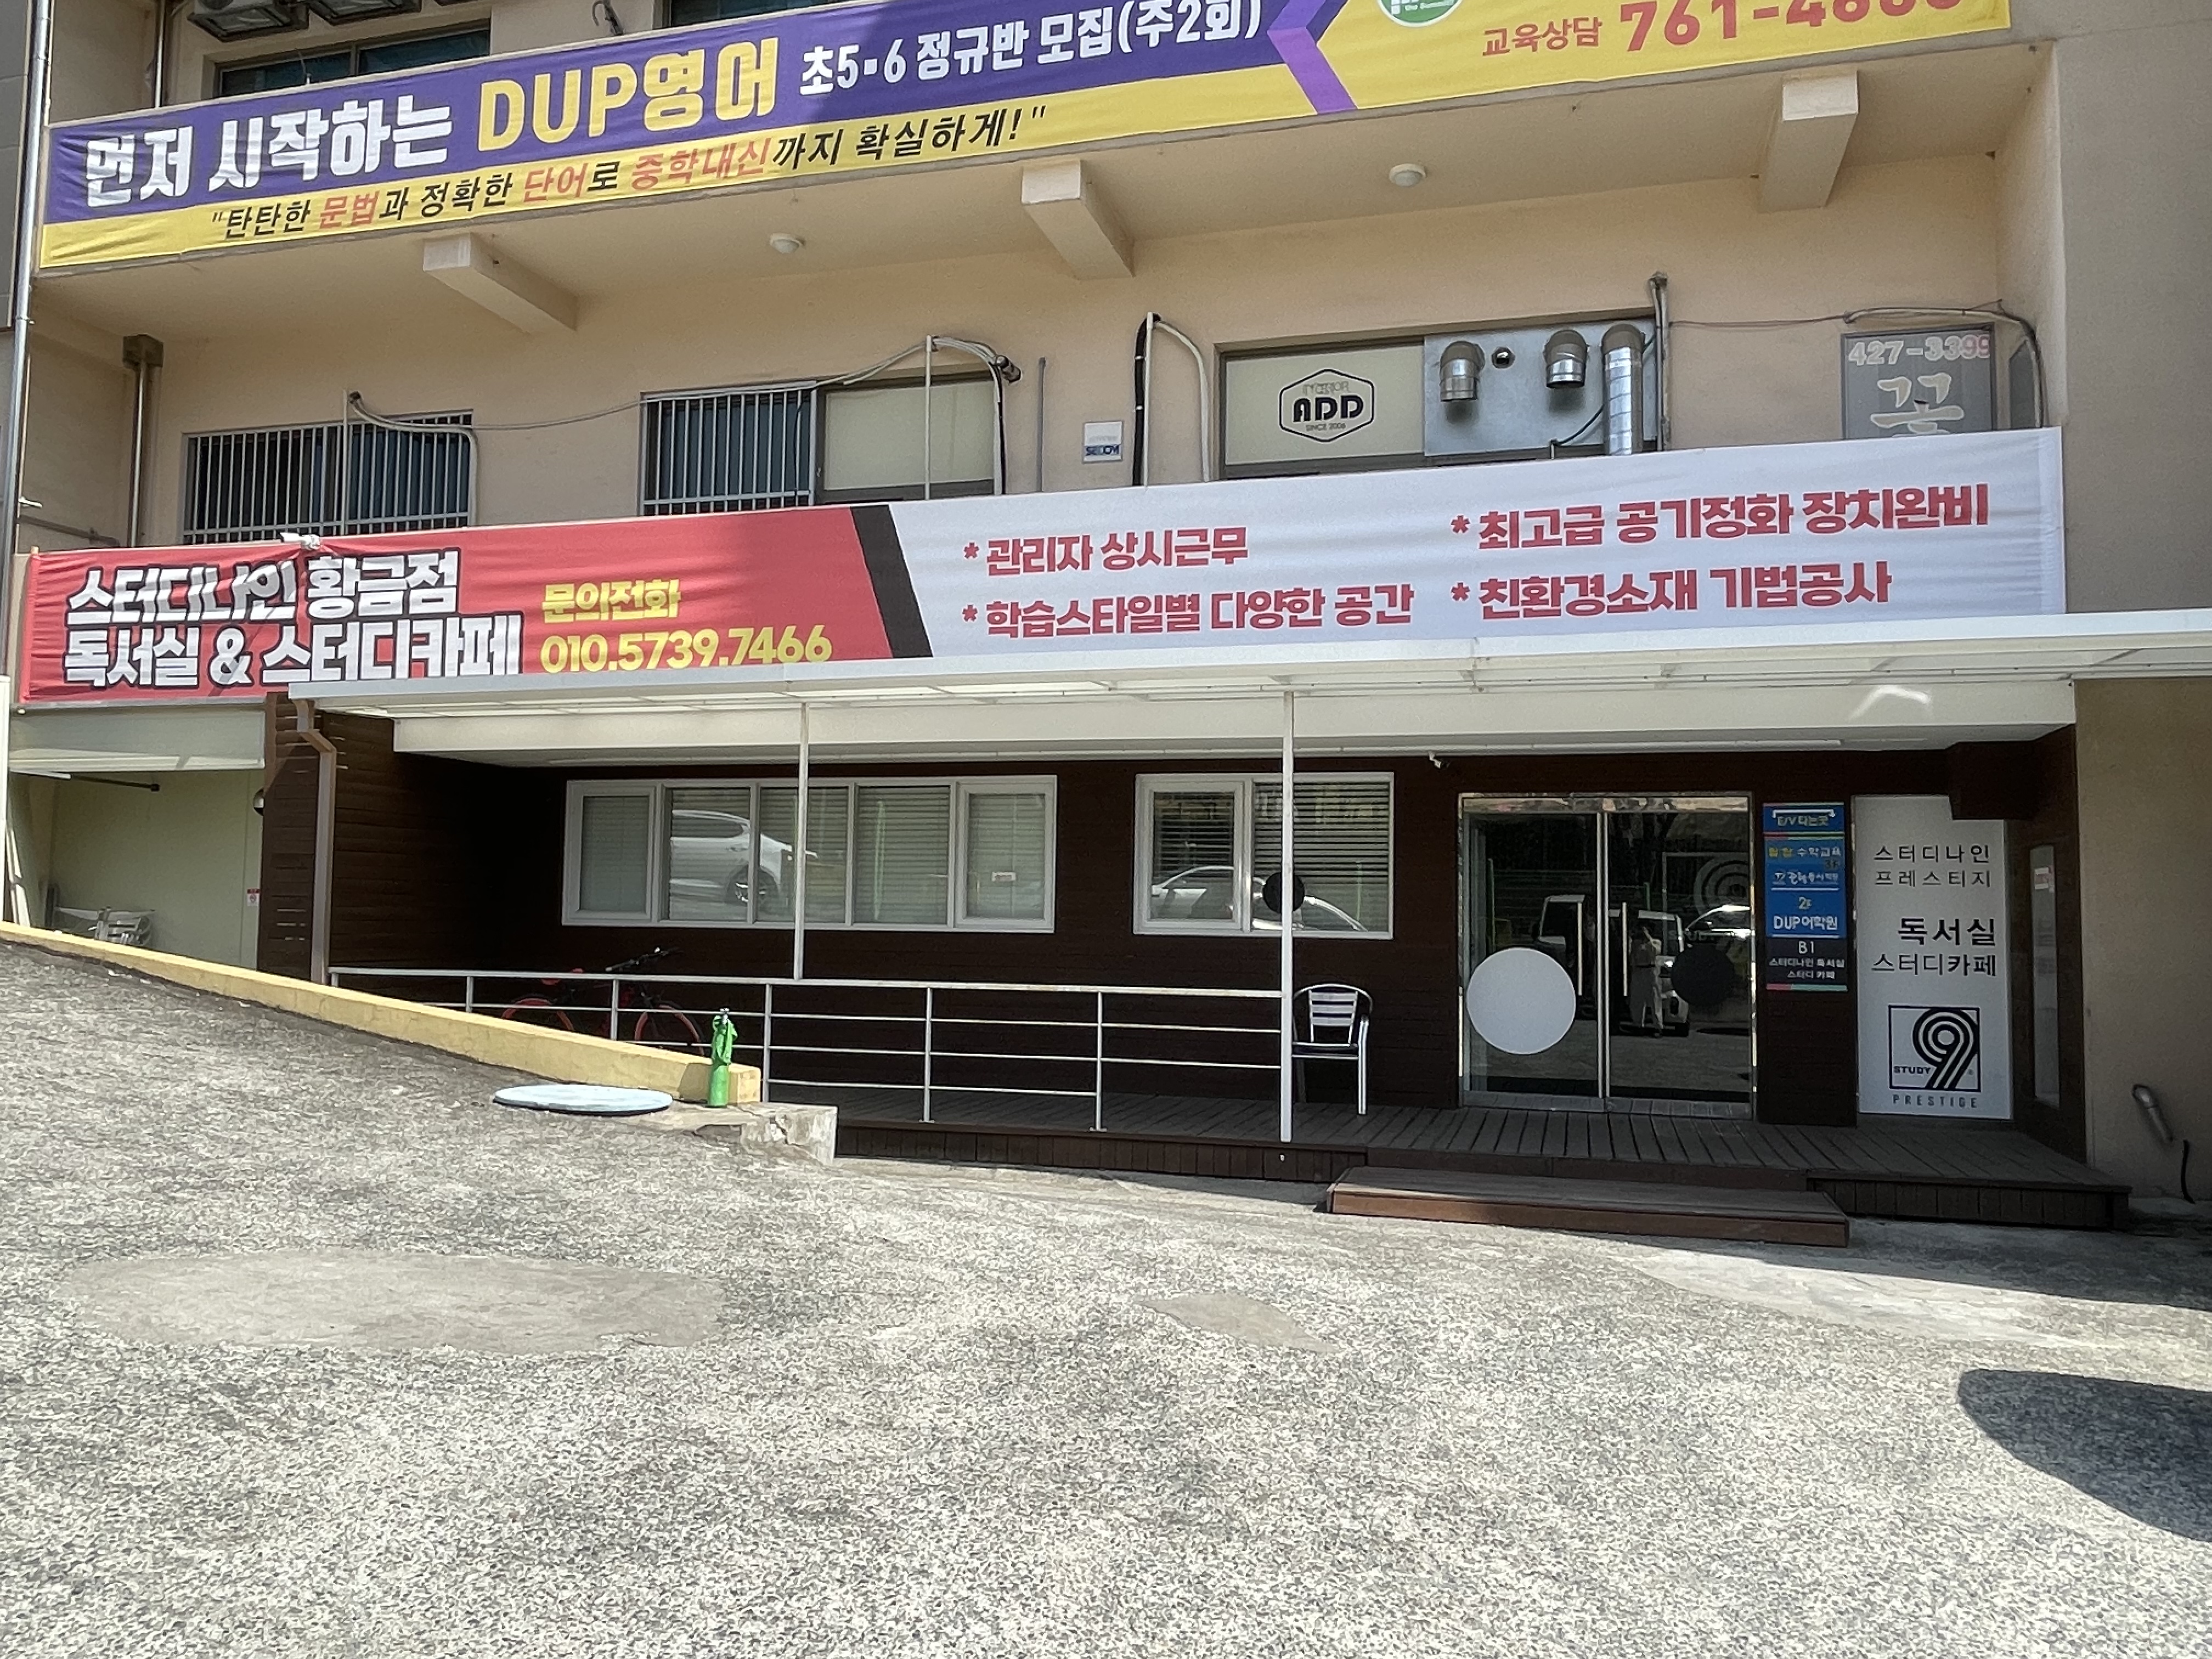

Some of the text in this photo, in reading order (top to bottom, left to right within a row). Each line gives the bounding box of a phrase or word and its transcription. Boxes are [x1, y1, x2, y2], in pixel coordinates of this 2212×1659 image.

[1483, 16, 1602, 56] 교육상담
[86, 125, 193, 208] 먼저
[208, 95, 453, 191] 시작하는
[478, 37, 779, 152] DUP영어
[916, 21, 1029, 81] 정규반
[1038, 0, 1261, 64] 모집(주2회)
[319, 187, 409, 227] 문법과
[420, 172, 513, 218] 정확한
[523, 160, 620, 204] 단어로
[631, 128, 843, 191] 중학내신까지
[1293, 395, 1364, 422] ADD
[1479, 484, 1988, 550] 최고급 공기정화 장치완비
[986, 527, 1249, 576] 관리자 상시근무
[67, 551, 459, 625] 스터디나인 황금점
[542, 579, 681, 623] 문의전화
[1480, 561, 1892, 620] 친환경소재 기법공사
[986, 584, 1414, 639] 학습스타일별 다양한 공간
[64, 614, 522, 689] 독서실 & 스터디카페
[541, 624, 832, 674] 010.5739.7466
[1874, 845, 1989, 864] 스터디나인
[1875, 870, 1990, 888] 프레스티지
[1798, 940, 1814, 954] B1
[1898, 918, 1996, 946] 독서실
[1871, 954, 1996, 977] 스터디카페
[1894, 1066, 1931, 1075] STUDY
[1893, 1094, 1978, 1108] PRESTIGE
